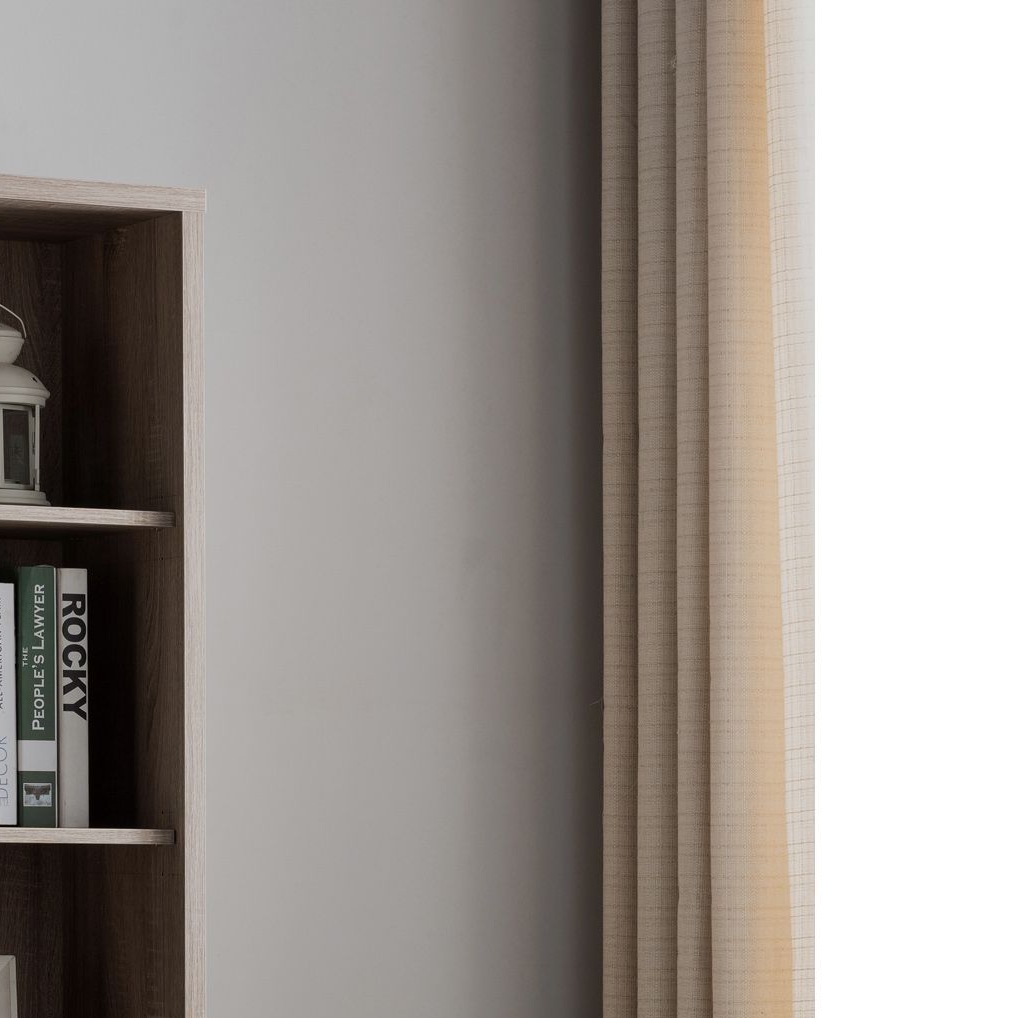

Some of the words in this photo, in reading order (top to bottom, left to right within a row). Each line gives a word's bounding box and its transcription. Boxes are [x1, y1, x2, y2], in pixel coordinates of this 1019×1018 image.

[32, 584, 46, 650] LAWYER
[32, 654, 46, 731] PEOPLE'S
[61, 593, 88, 721] ROCKY
